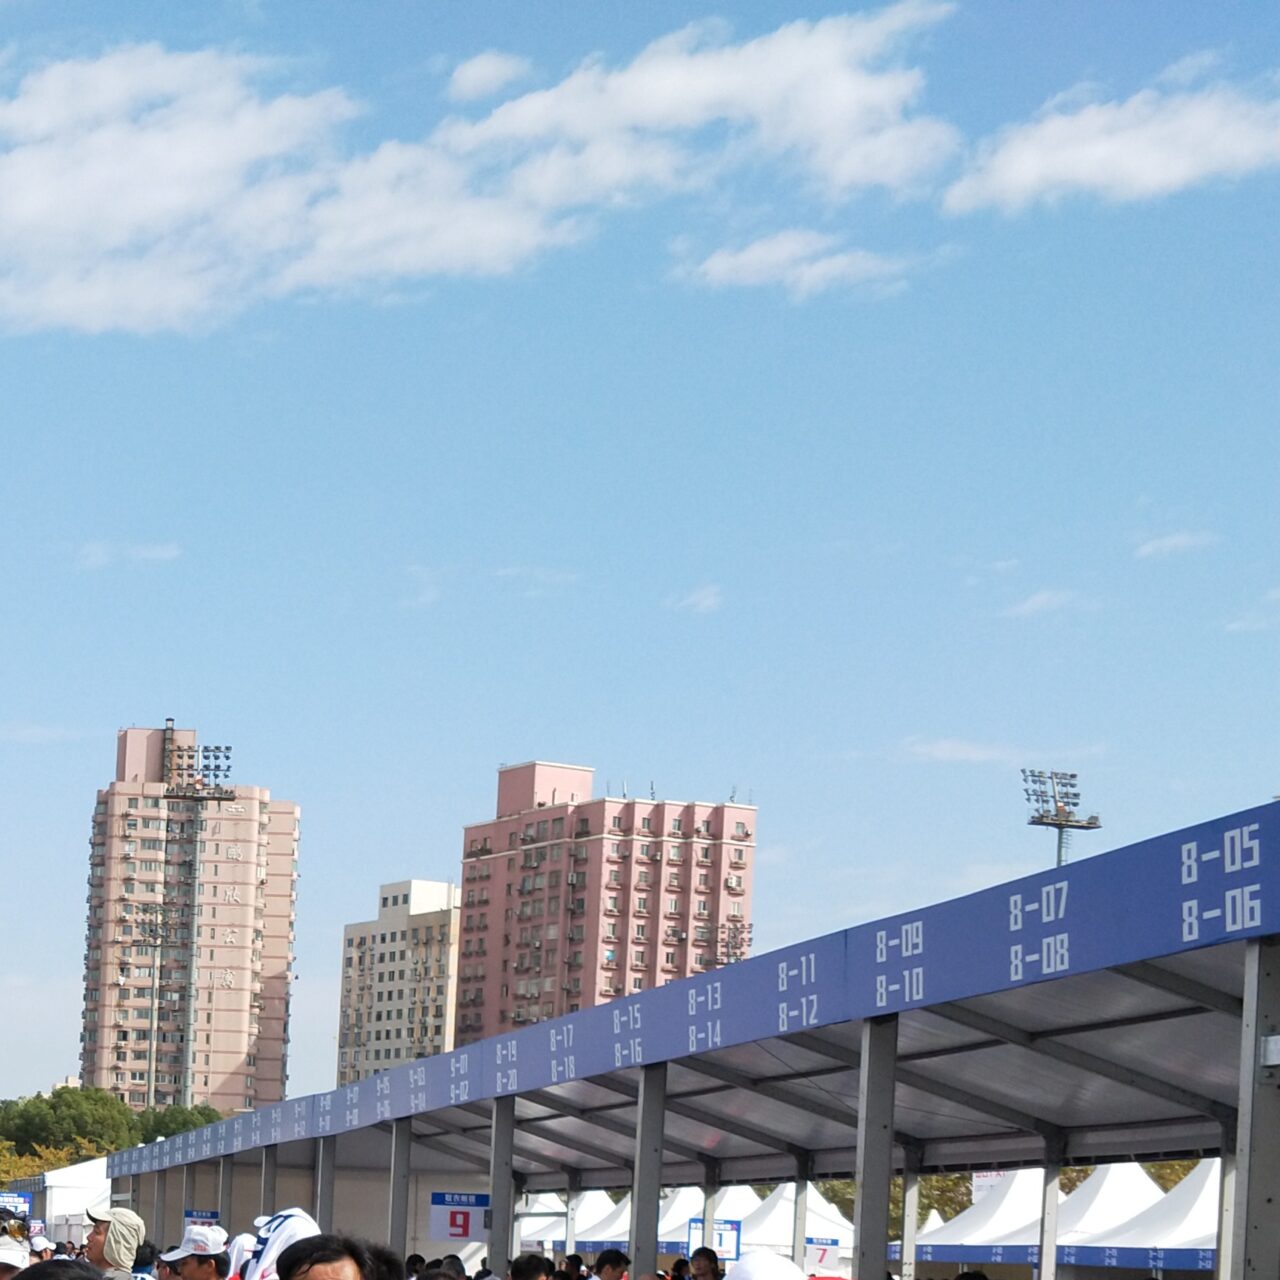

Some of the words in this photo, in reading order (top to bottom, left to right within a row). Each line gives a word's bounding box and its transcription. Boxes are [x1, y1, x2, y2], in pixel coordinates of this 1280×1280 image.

[1181, 823, 1260, 885] 8-05
[1009, 880, 1069, 931] 8-07
[1182, 883, 1262, 943] 8-06
[876, 921, 923, 963] 8-09
[1010, 932, 1070, 982] 8-08
[778, 954, 816, 992] 8-11
[876, 967, 924, 1007] 8-10
[688, 982, 721, 1016] 8-13
[778, 994, 818, 1032] 8-12
[613, 1004, 642, 1034] 8-15
[689, 1019, 721, 1052] 8-14
[496, 1041, 517, 1064] 8-19
[550, 1025, 573, 1052] 8-17
[615, 1039, 643, 1068] 8-16
[496, 1069, 518, 1093] 8-20
[551, 1055, 575, 1082] 8-18
[450, 1081, 469, 1104] 9-02
[449, 1211, 470, 1238] 9
[816, 1248, 827, 1264] 7
